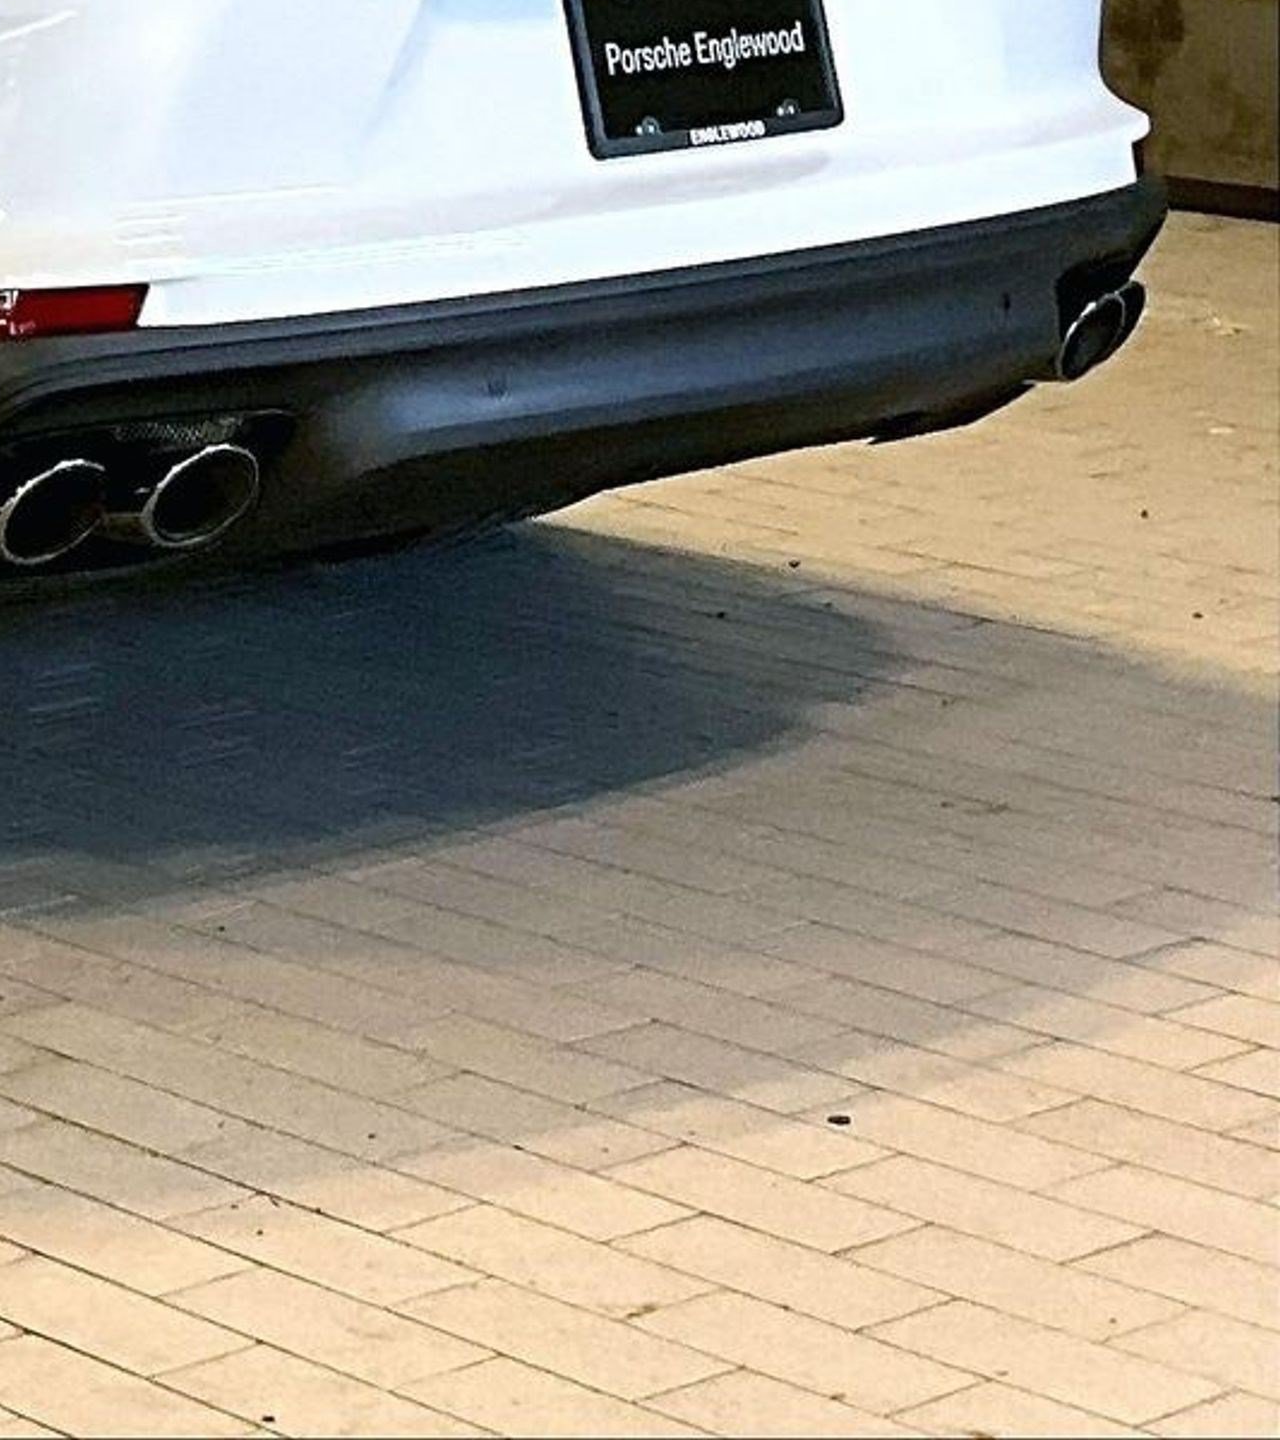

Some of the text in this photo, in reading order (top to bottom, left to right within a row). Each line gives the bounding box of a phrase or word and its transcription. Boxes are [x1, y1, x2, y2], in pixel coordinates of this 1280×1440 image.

[605, 21, 805, 75] Porsche Englewood
[690, 120, 766, 145] ENGLEWOOD
